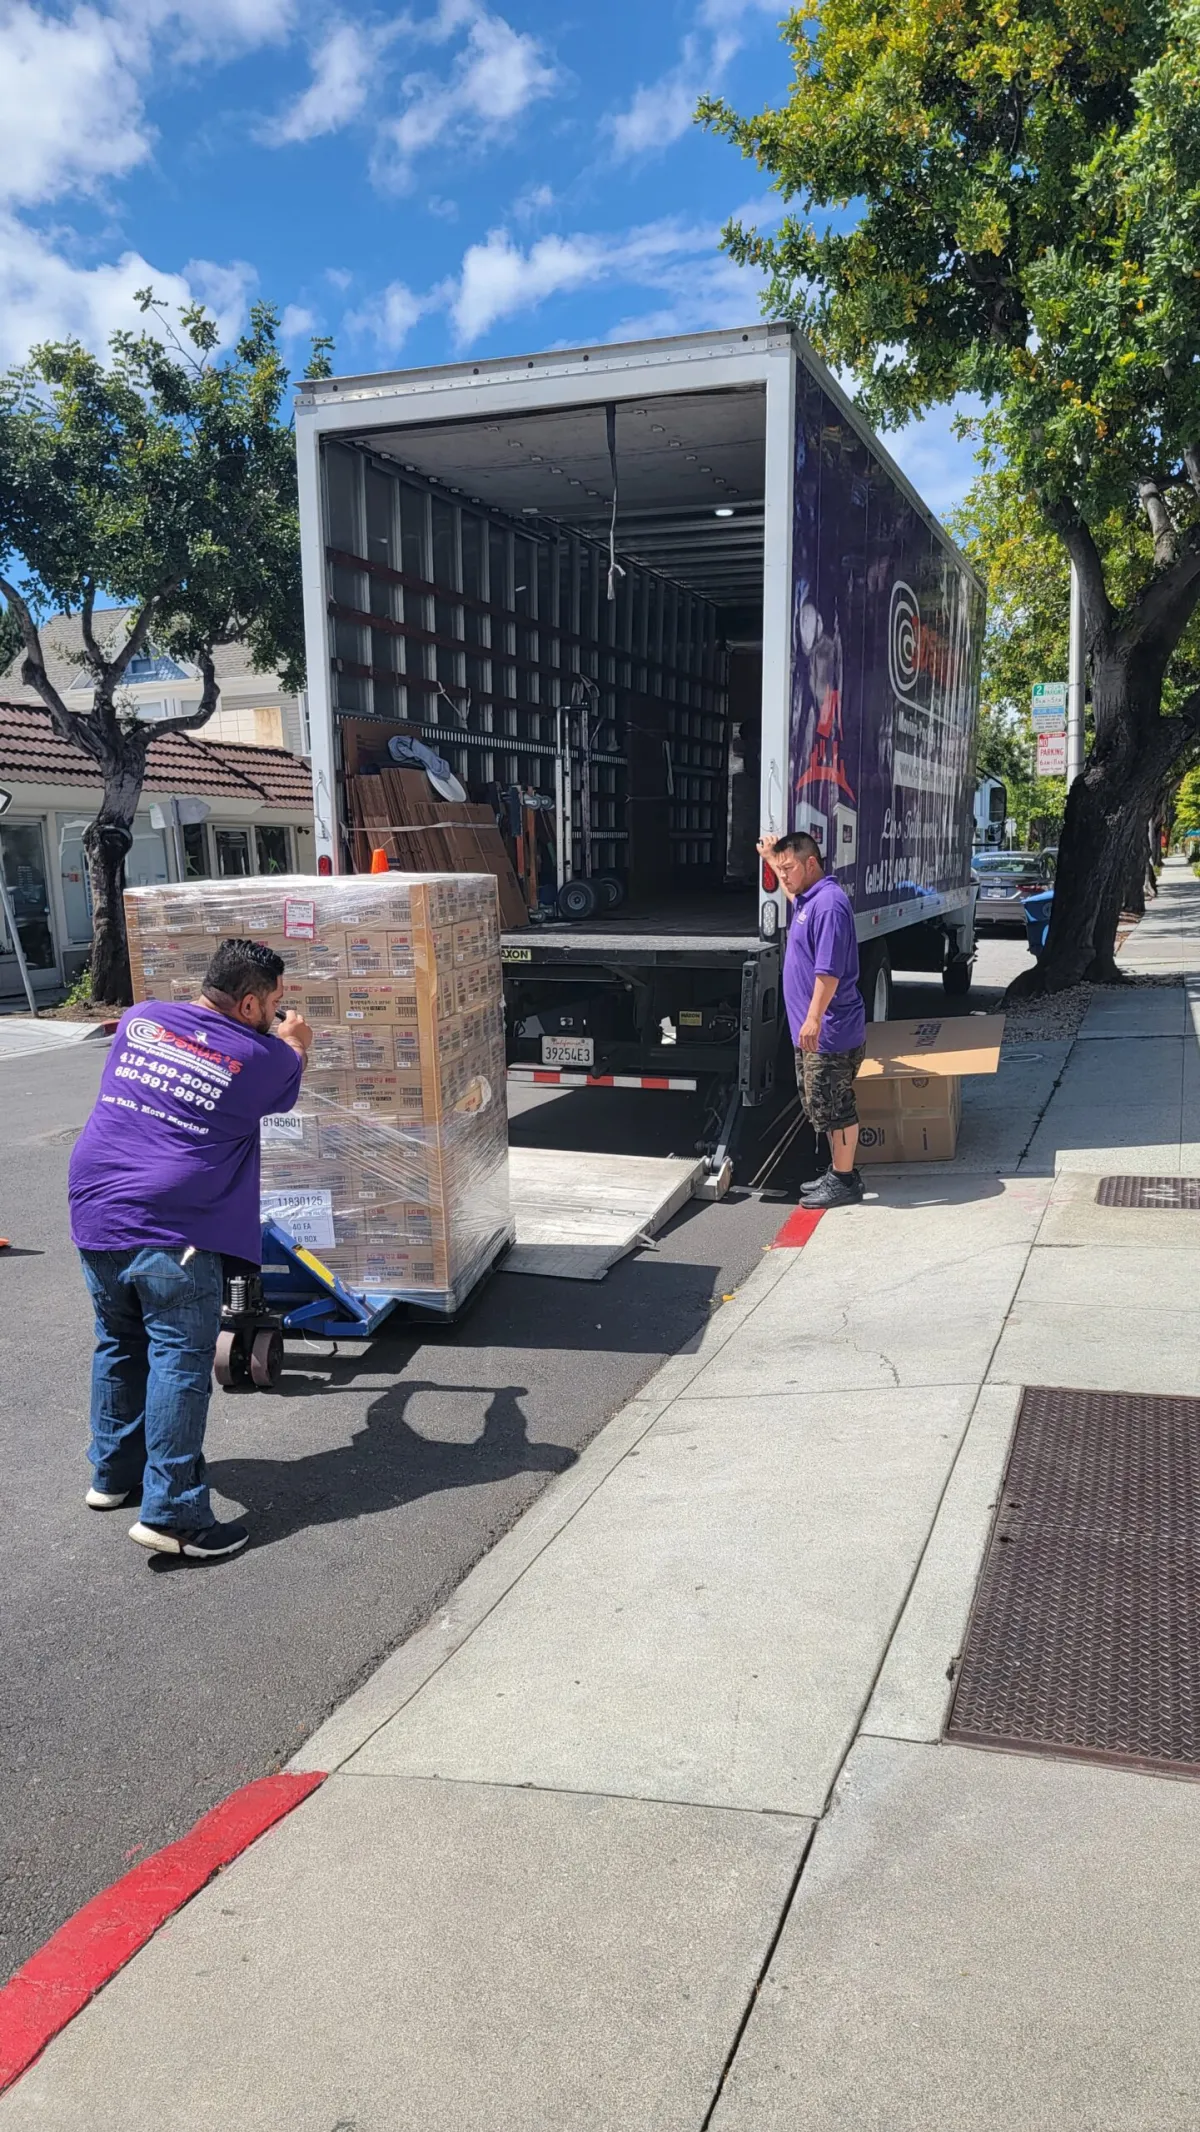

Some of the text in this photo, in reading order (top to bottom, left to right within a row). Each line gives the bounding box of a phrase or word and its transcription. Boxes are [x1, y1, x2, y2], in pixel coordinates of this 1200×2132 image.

[1036, 685, 1043, 695] 2
[1039, 738, 1048, 747] NO
[1040, 748, 1064, 757] PARKING
[501, 950, 529, 959] AXON
[545, 1046, 590, 1062] 39254E3
[119, 1051, 223, 1100] 415-499-2093
[114, 1065, 216, 1111] 650-391-9570
[102, 1093, 116, 1104] Less
[116, 1096, 139, 1112] Talk,
[140, 1104, 166, 1119] More
[277, 1195, 324, 1208] 11830125
[304, 1235, 318, 1243] BOX
